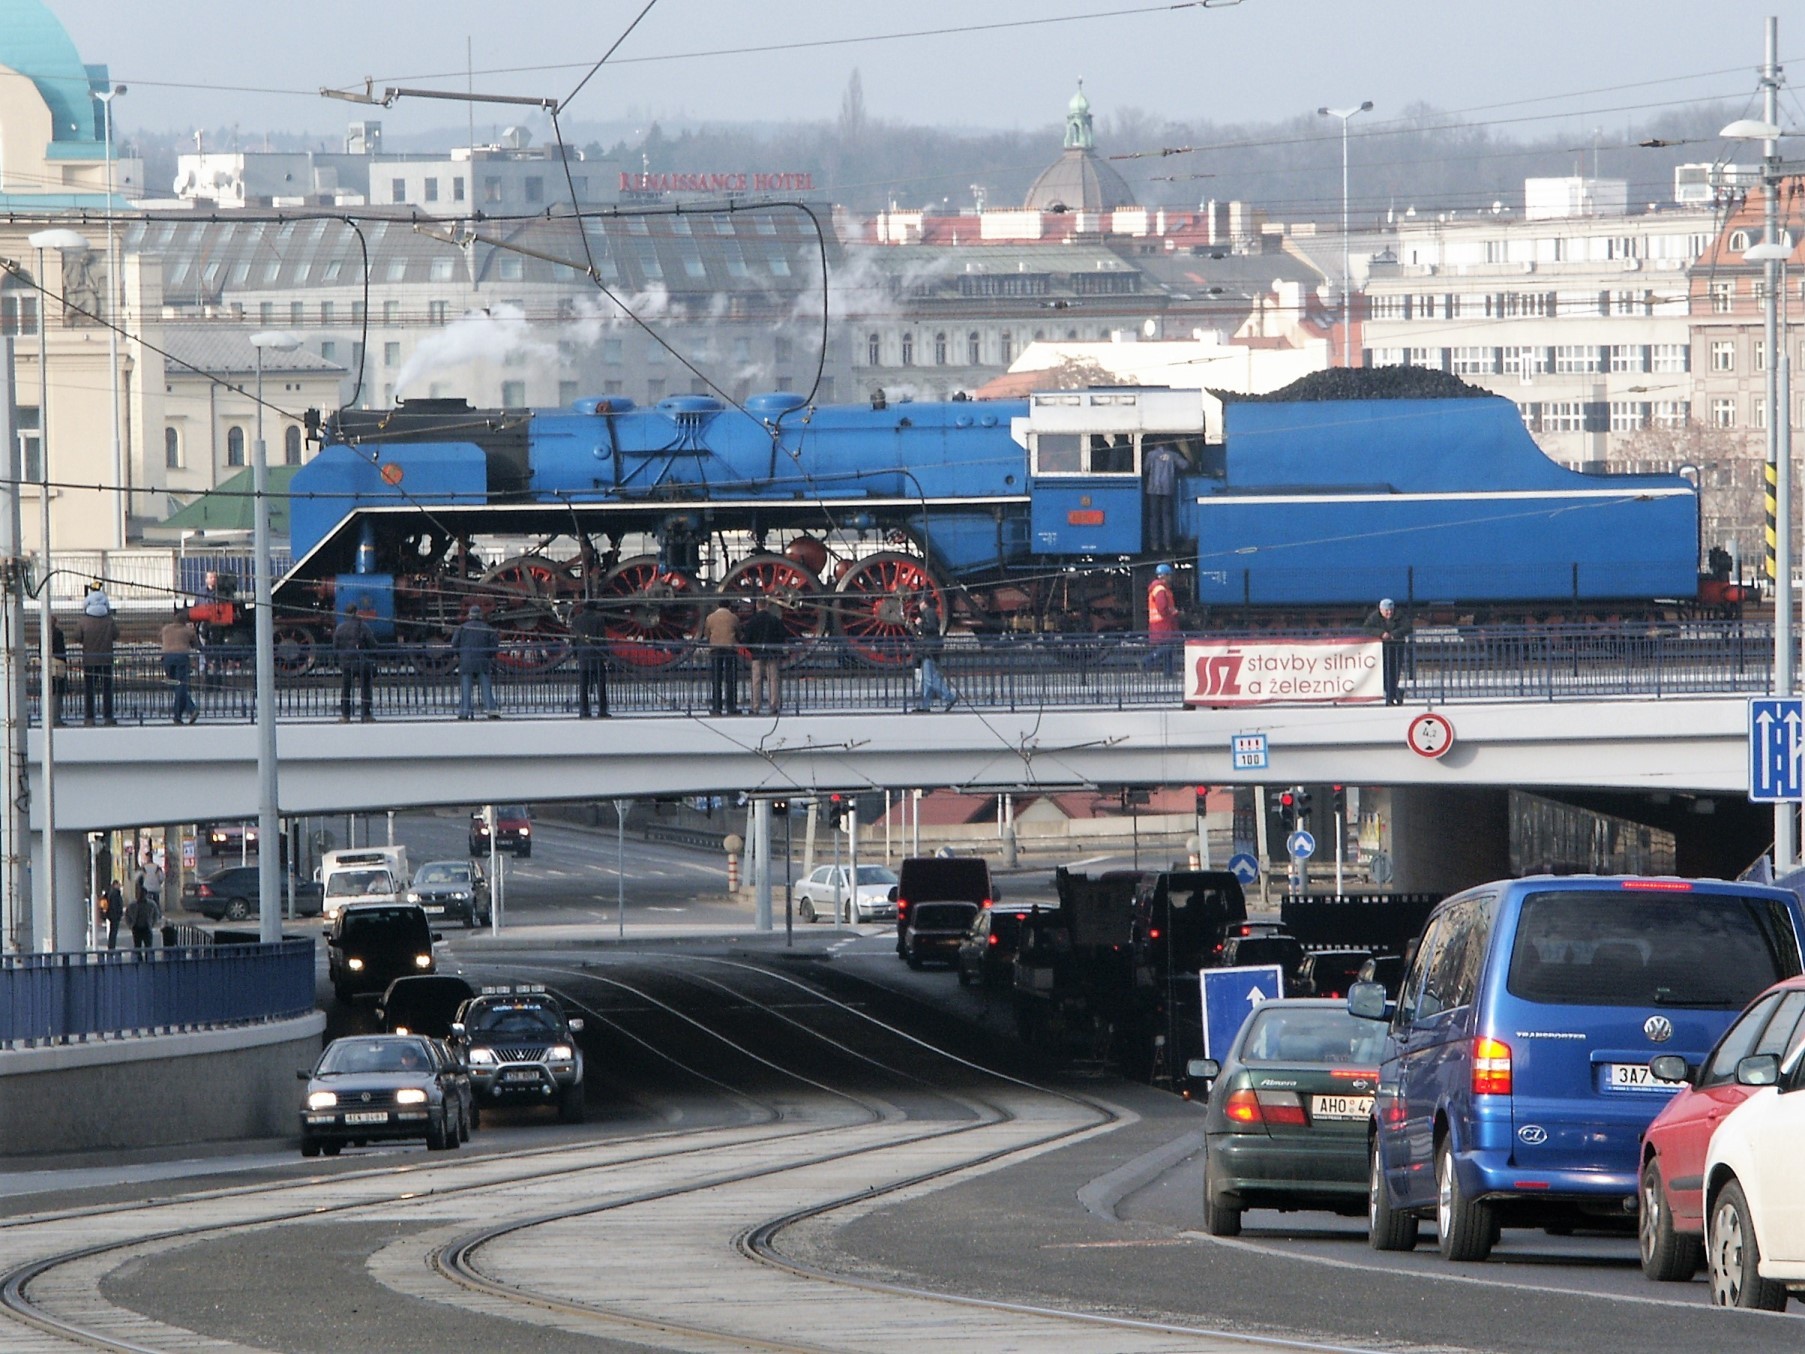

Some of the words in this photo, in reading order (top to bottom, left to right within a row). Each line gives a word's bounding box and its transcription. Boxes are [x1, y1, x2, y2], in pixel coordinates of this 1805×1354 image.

[619, 171, 748, 192] RENAISSANCE
[754, 171, 816, 191] HOTEL
[1247, 653, 1318, 674] stavby
[1324, 653, 1377, 671] silnic
[1248, 682, 1262, 694] a
[1269, 675, 1356, 694] železnic
[1242, 754, 1260, 765] 100
[1260, 1079, 1298, 1087] Almera
